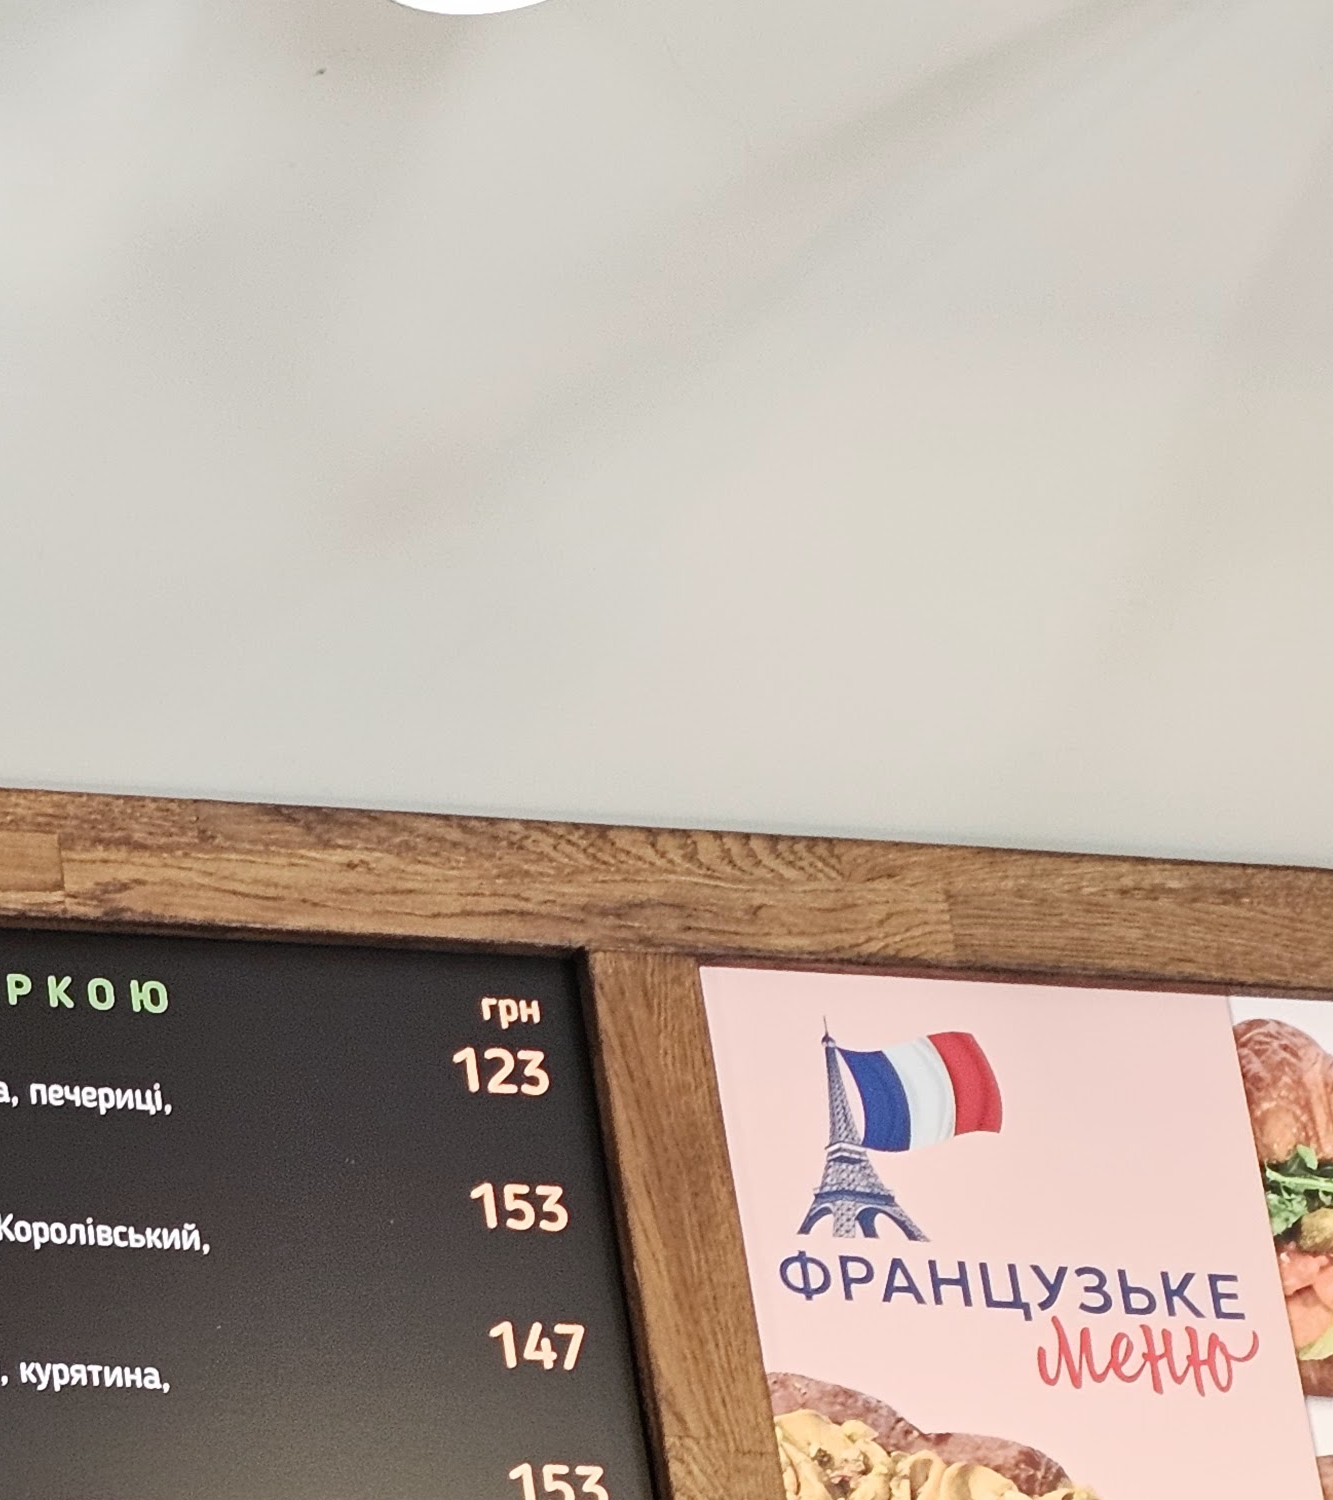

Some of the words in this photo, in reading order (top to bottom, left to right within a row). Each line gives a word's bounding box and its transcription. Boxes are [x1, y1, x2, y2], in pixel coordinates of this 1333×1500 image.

[479, 995, 542, 1031] грн
[451, 1045, 551, 1097] 123
[468, 1181, 570, 1233] 153
[778, 1249, 1247, 1322] ФРАНЦУЗЬКЕ
[487, 1319, 586, 1372] 147
[1035, 1314, 1260, 1398] Меню
[18, 1360, 172, 1395] курятина,
